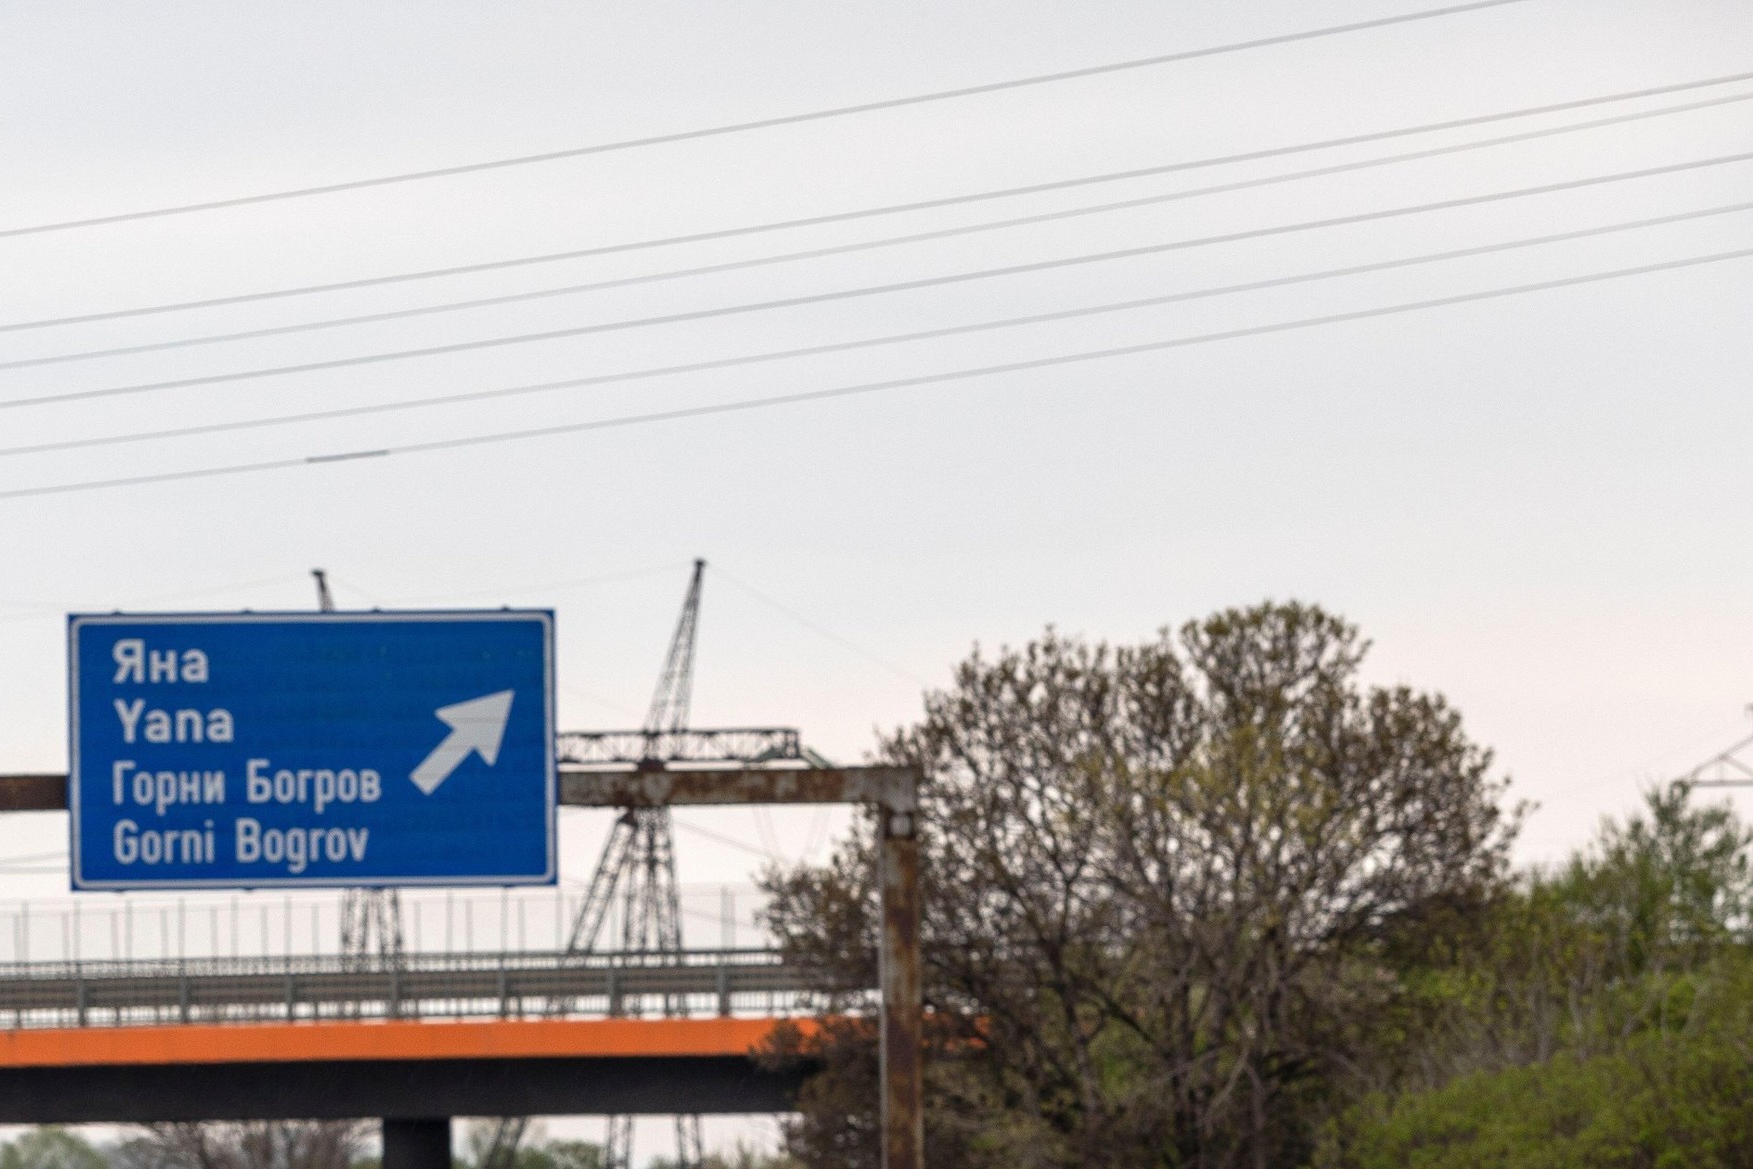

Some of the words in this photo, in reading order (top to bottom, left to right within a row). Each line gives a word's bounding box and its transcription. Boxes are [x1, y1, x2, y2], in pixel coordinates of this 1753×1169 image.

[112, 638, 209, 684] Яна
[113, 698, 235, 743] Yana
[112, 759, 226, 816] Горни
[246, 758, 382, 814] Богров
[113, 818, 215, 865] Gorni
[235, 817, 369, 874] Bogrov
